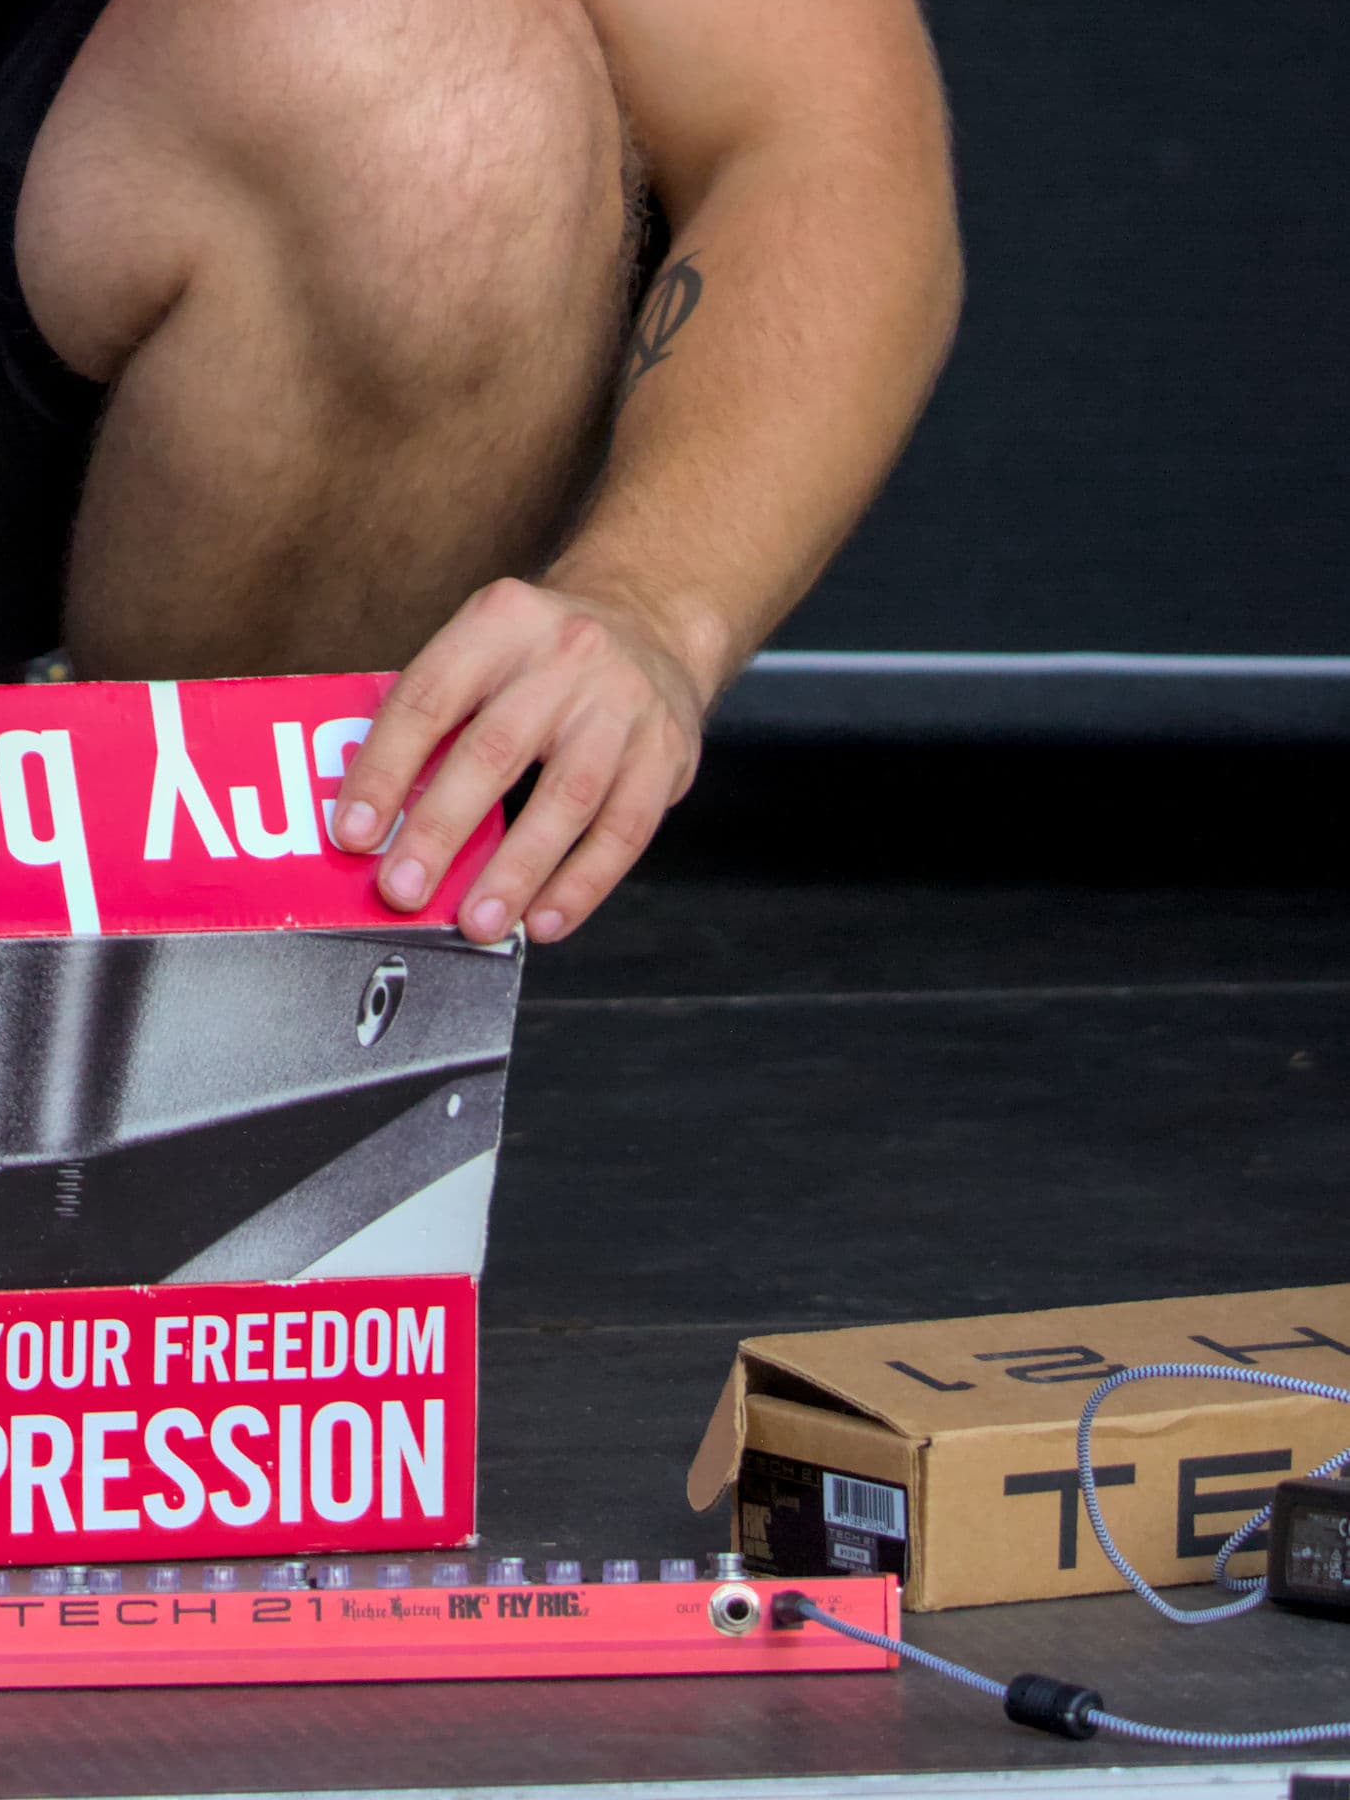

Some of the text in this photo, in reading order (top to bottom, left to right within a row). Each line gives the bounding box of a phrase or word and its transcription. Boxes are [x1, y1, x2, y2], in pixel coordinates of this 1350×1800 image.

[154, 1306, 448, 1384] FREEDOM
[1003, 1448, 1350, 1571] TE
[0, 1598, 217, 1628] TECH
[252, 1596, 324, 1623] 21
[497, 1592, 534, 1618] FLY
[676, 1602, 701, 1615] OUT
